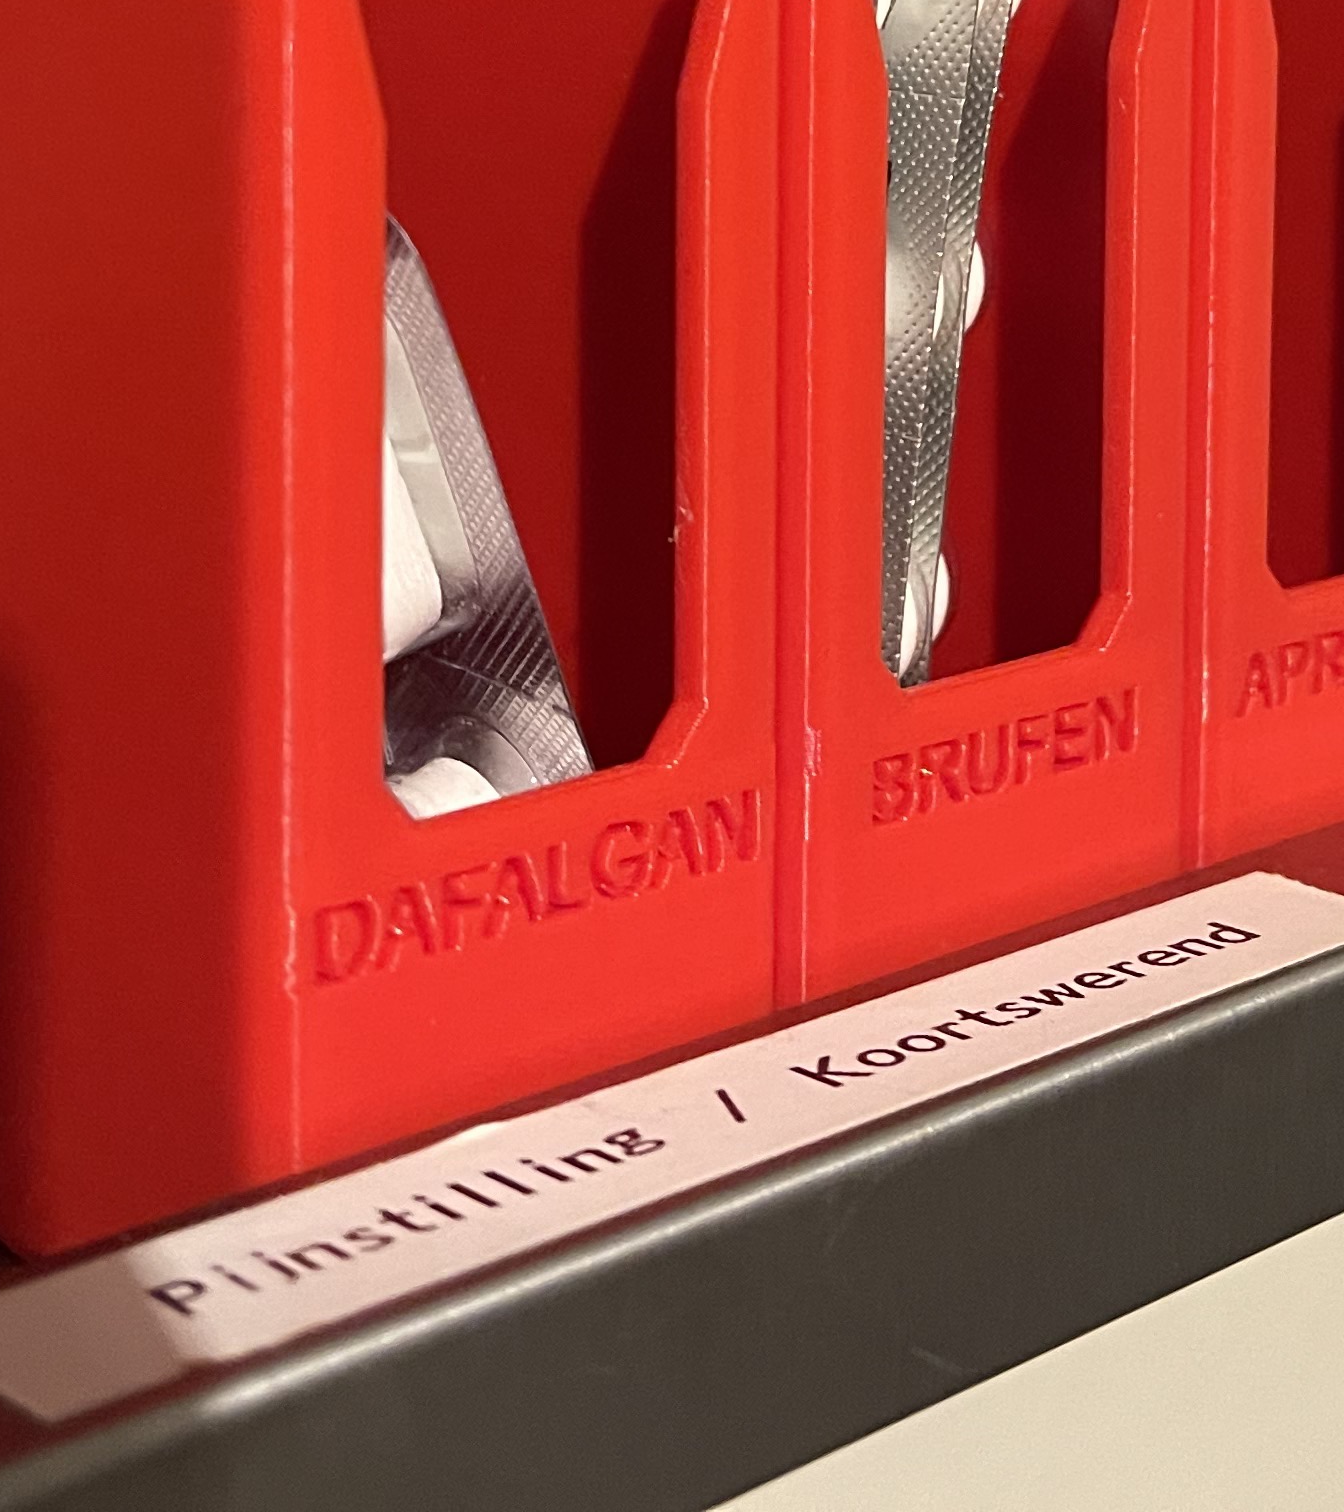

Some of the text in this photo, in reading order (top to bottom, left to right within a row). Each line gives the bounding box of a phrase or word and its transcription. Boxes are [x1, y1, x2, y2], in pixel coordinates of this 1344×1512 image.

[871, 688, 1138, 826] BRUFEN
[314, 790, 762, 988] DAFALGAN
[150, 922, 1262, 1322] Pijnstilling / Koortswerend
